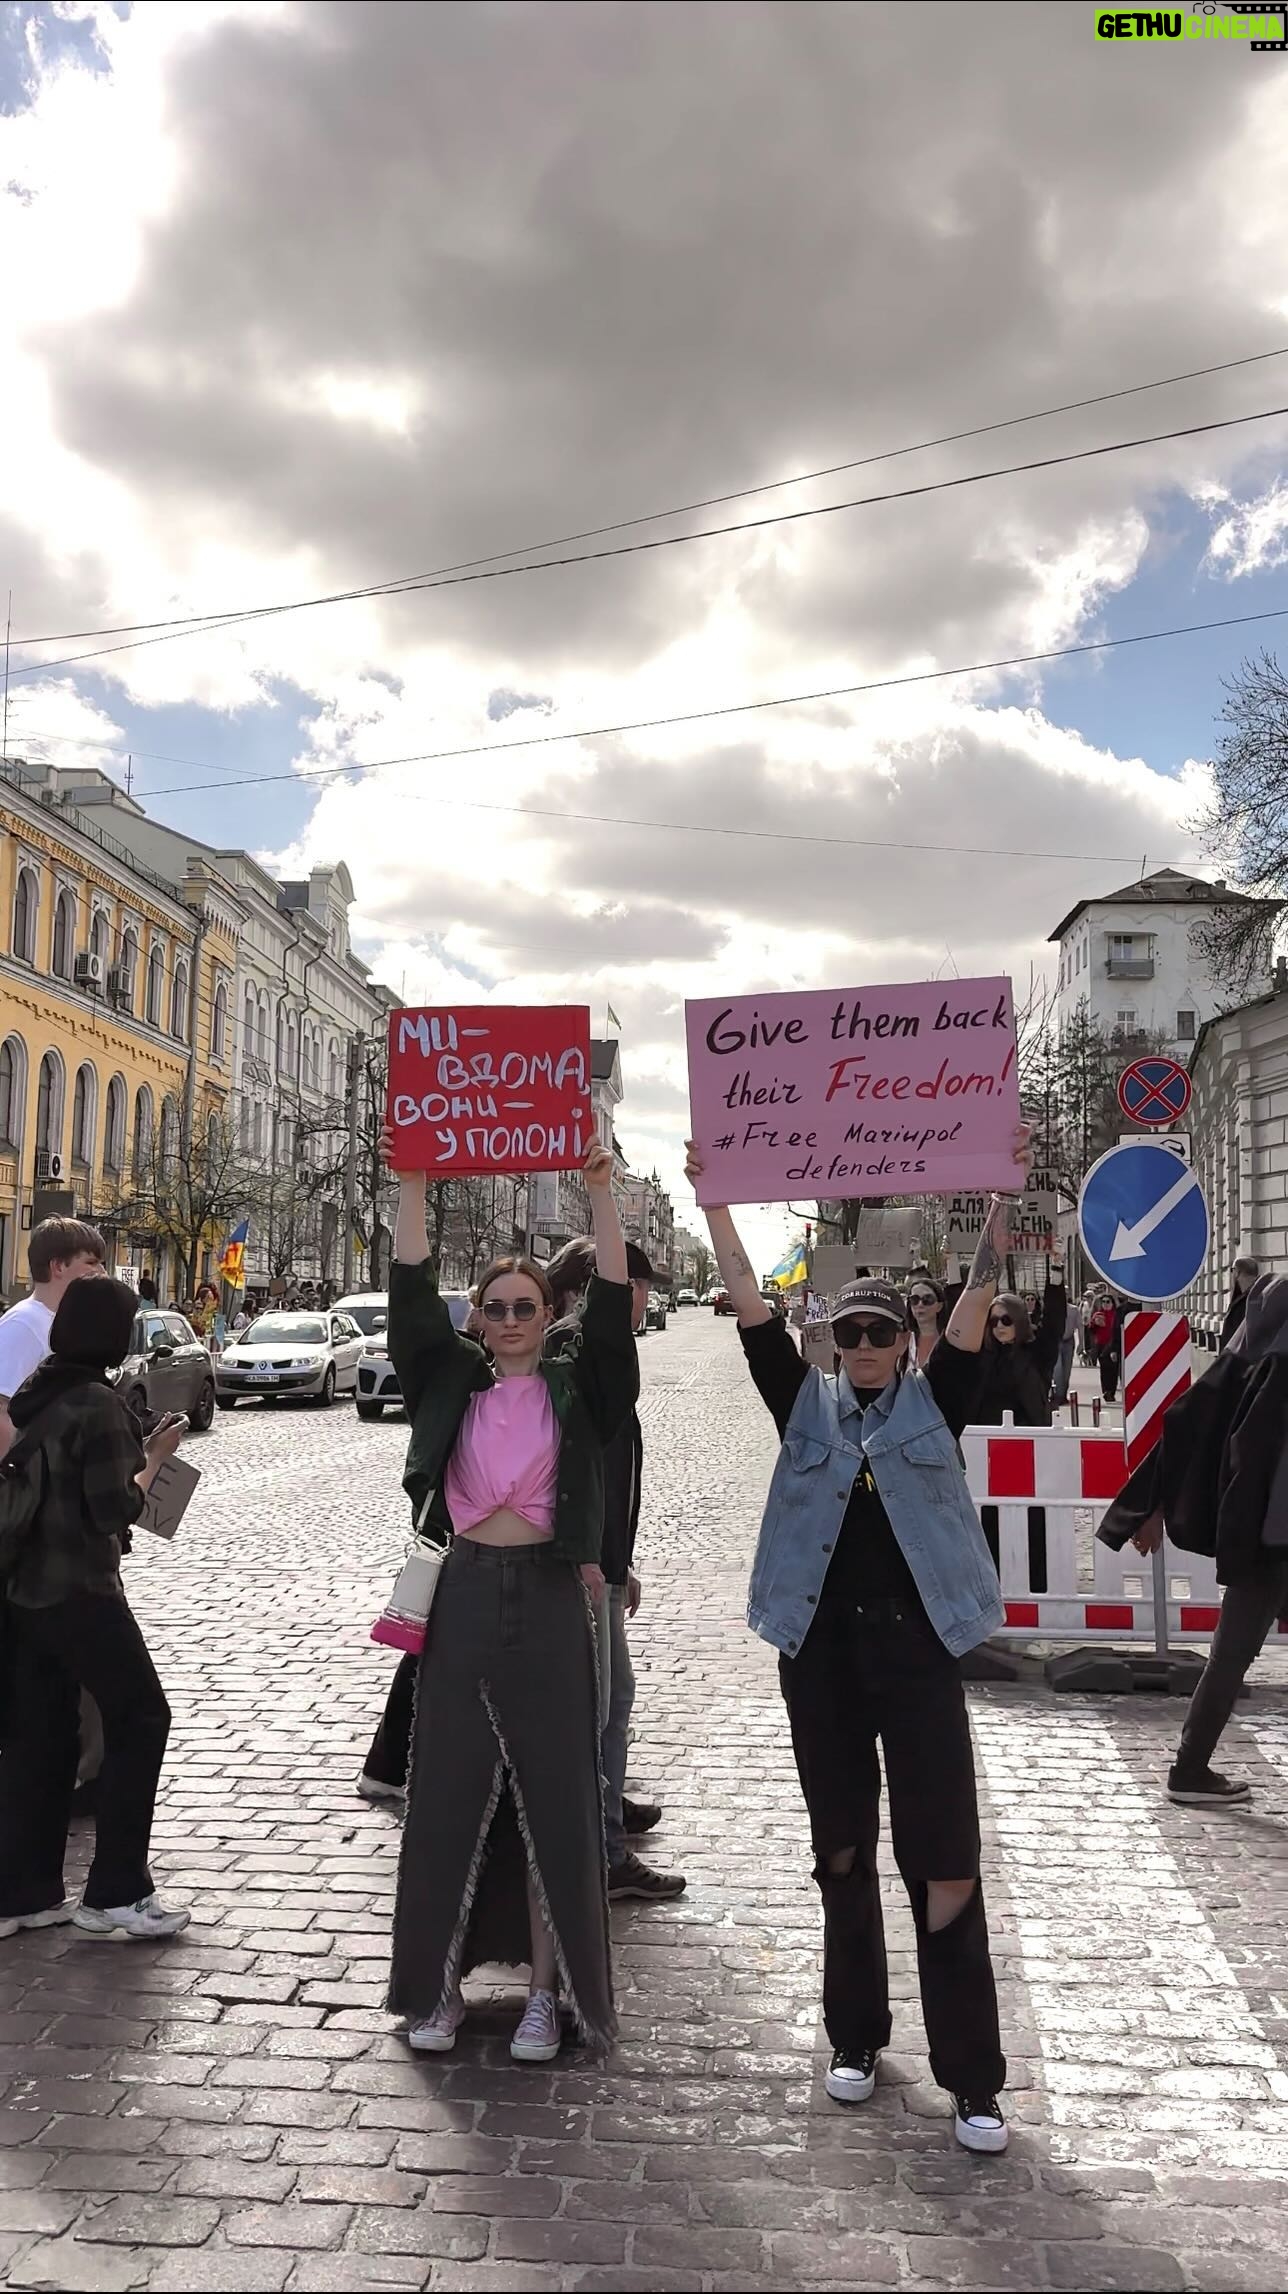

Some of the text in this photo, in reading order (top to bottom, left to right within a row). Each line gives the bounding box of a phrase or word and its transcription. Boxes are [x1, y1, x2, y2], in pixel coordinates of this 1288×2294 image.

[706, 995, 1008, 1055] Give them back
[722, 1044, 1015, 1109] their Freedom!
[844, 1121, 962, 1152] Mariupol
[786, 1154, 926, 1181] defenders
[1025, 1172, 1057, 1192] ЕНЬ
[948, 1197, 985, 1214] ДЛЯ
[841, 1290, 892, 1302] CORRUPTION
